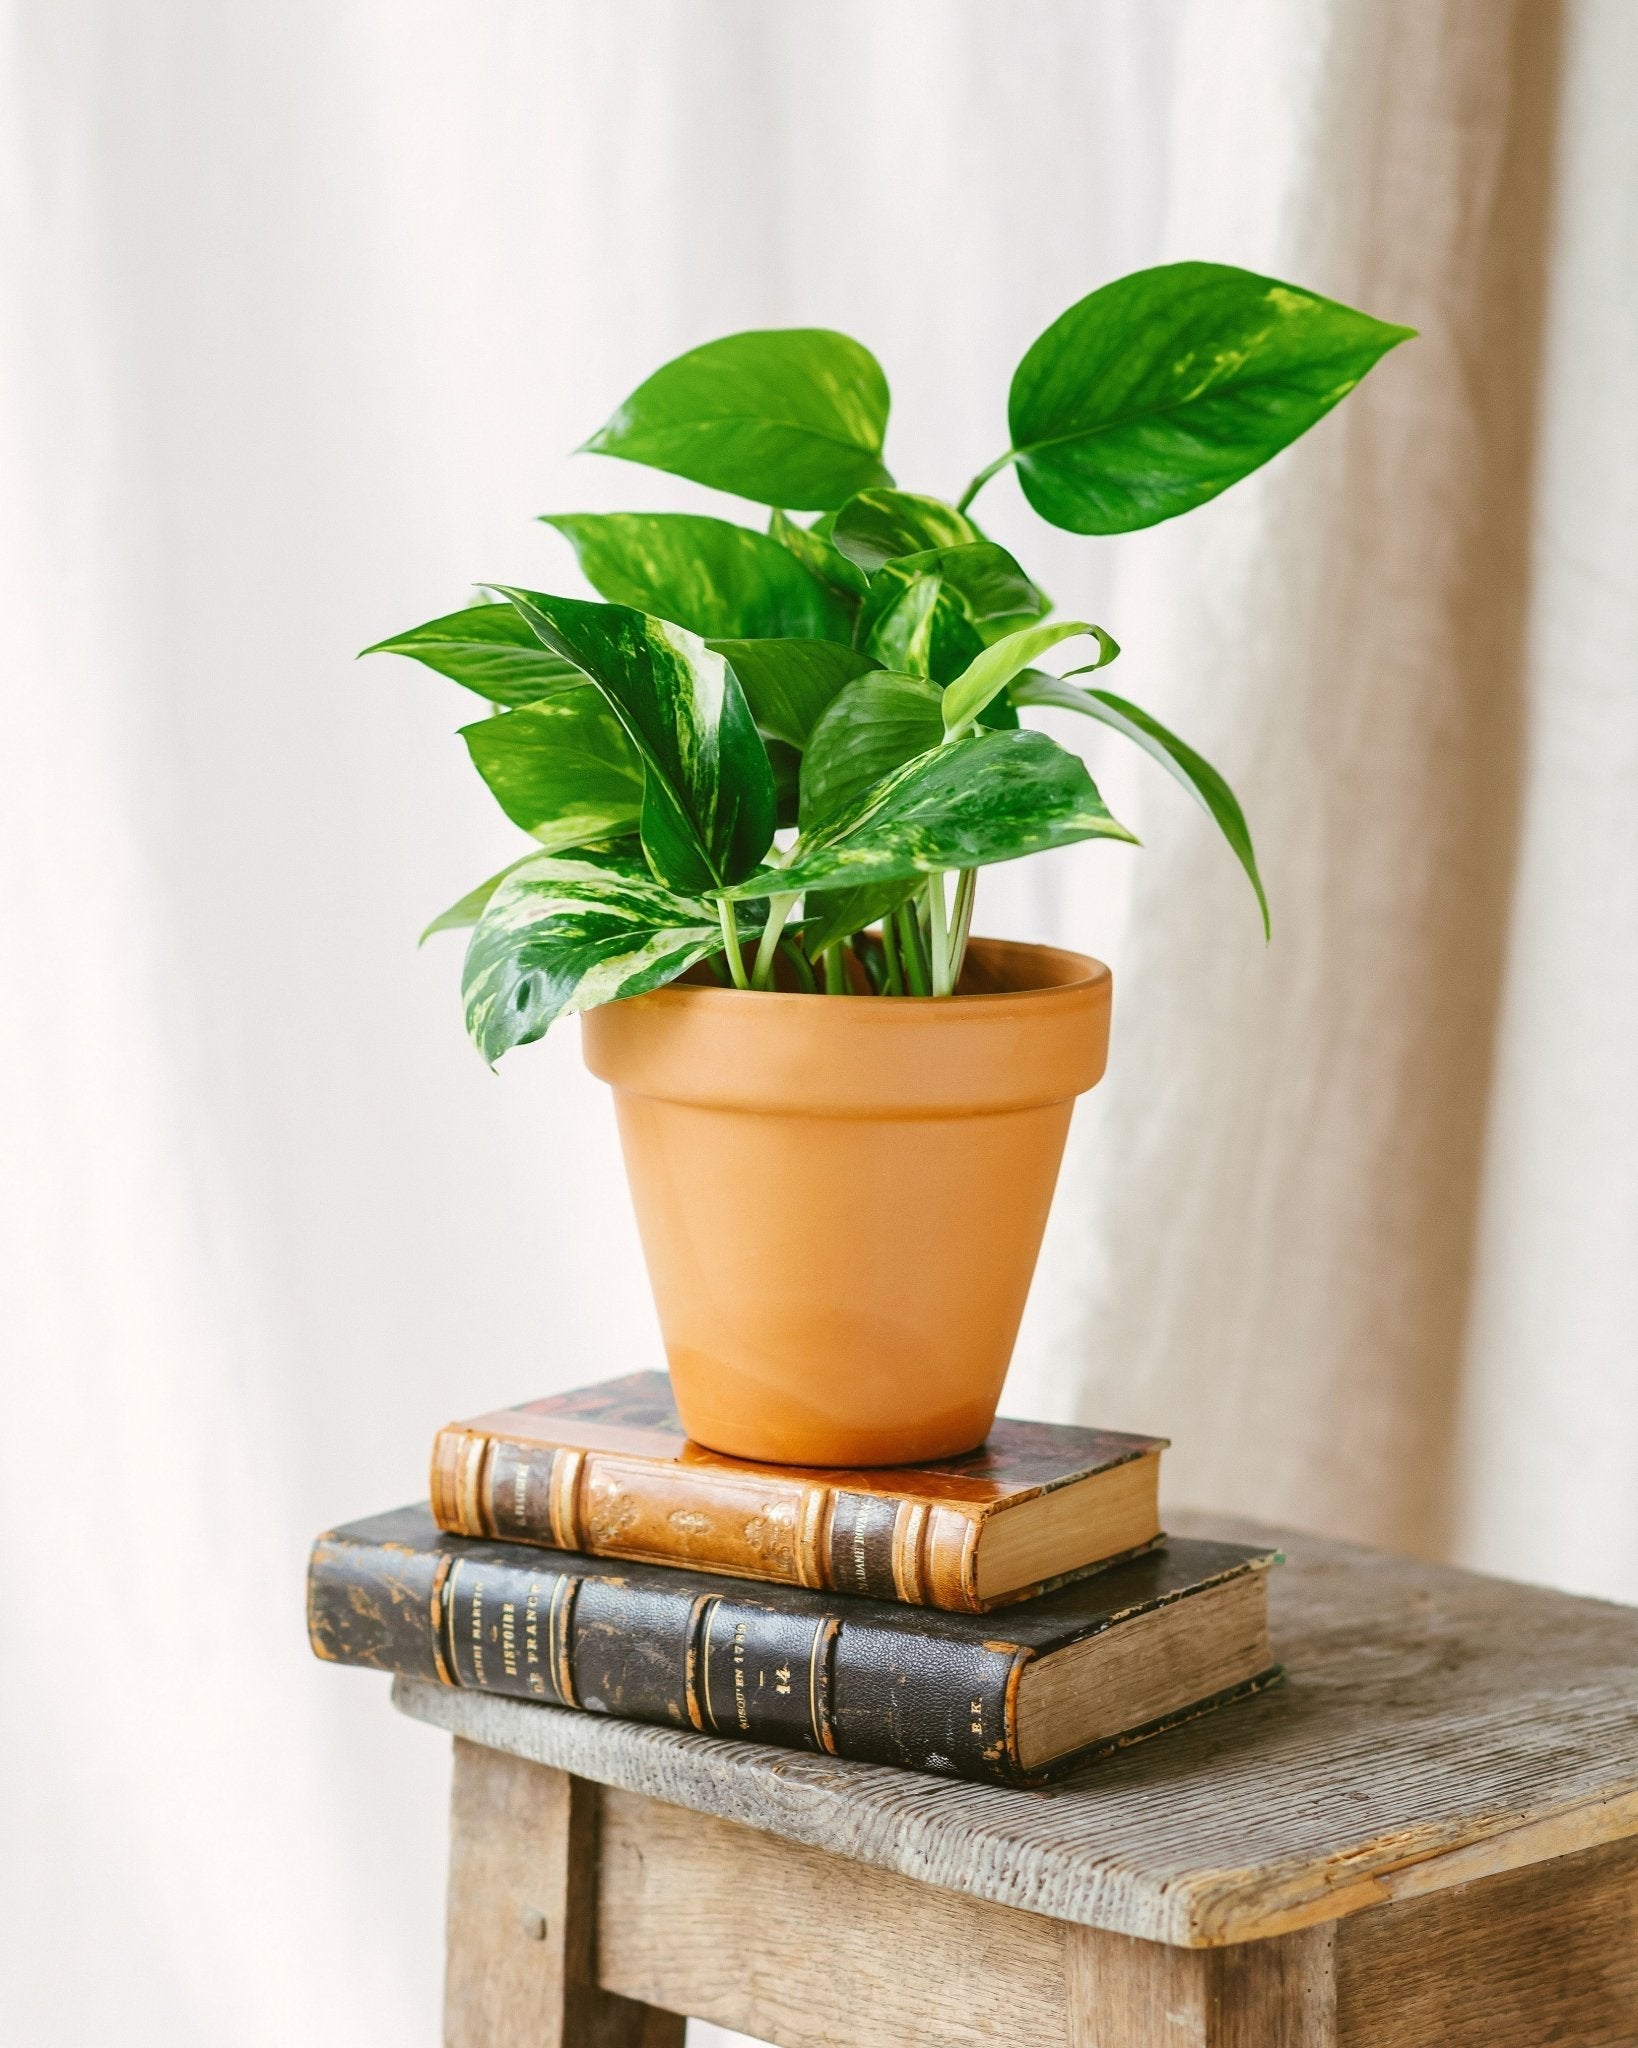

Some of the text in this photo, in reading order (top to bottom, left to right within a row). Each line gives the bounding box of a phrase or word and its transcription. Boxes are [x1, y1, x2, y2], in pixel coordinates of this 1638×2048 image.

[472, 1582, 483, 1639] MARTIN
[526, 1584, 541, 1664] FRANCE
[502, 1603, 517, 1676] HISTOIRE
[734, 1623, 748, 1663] 1789
[775, 1664, 791, 1694] 14
